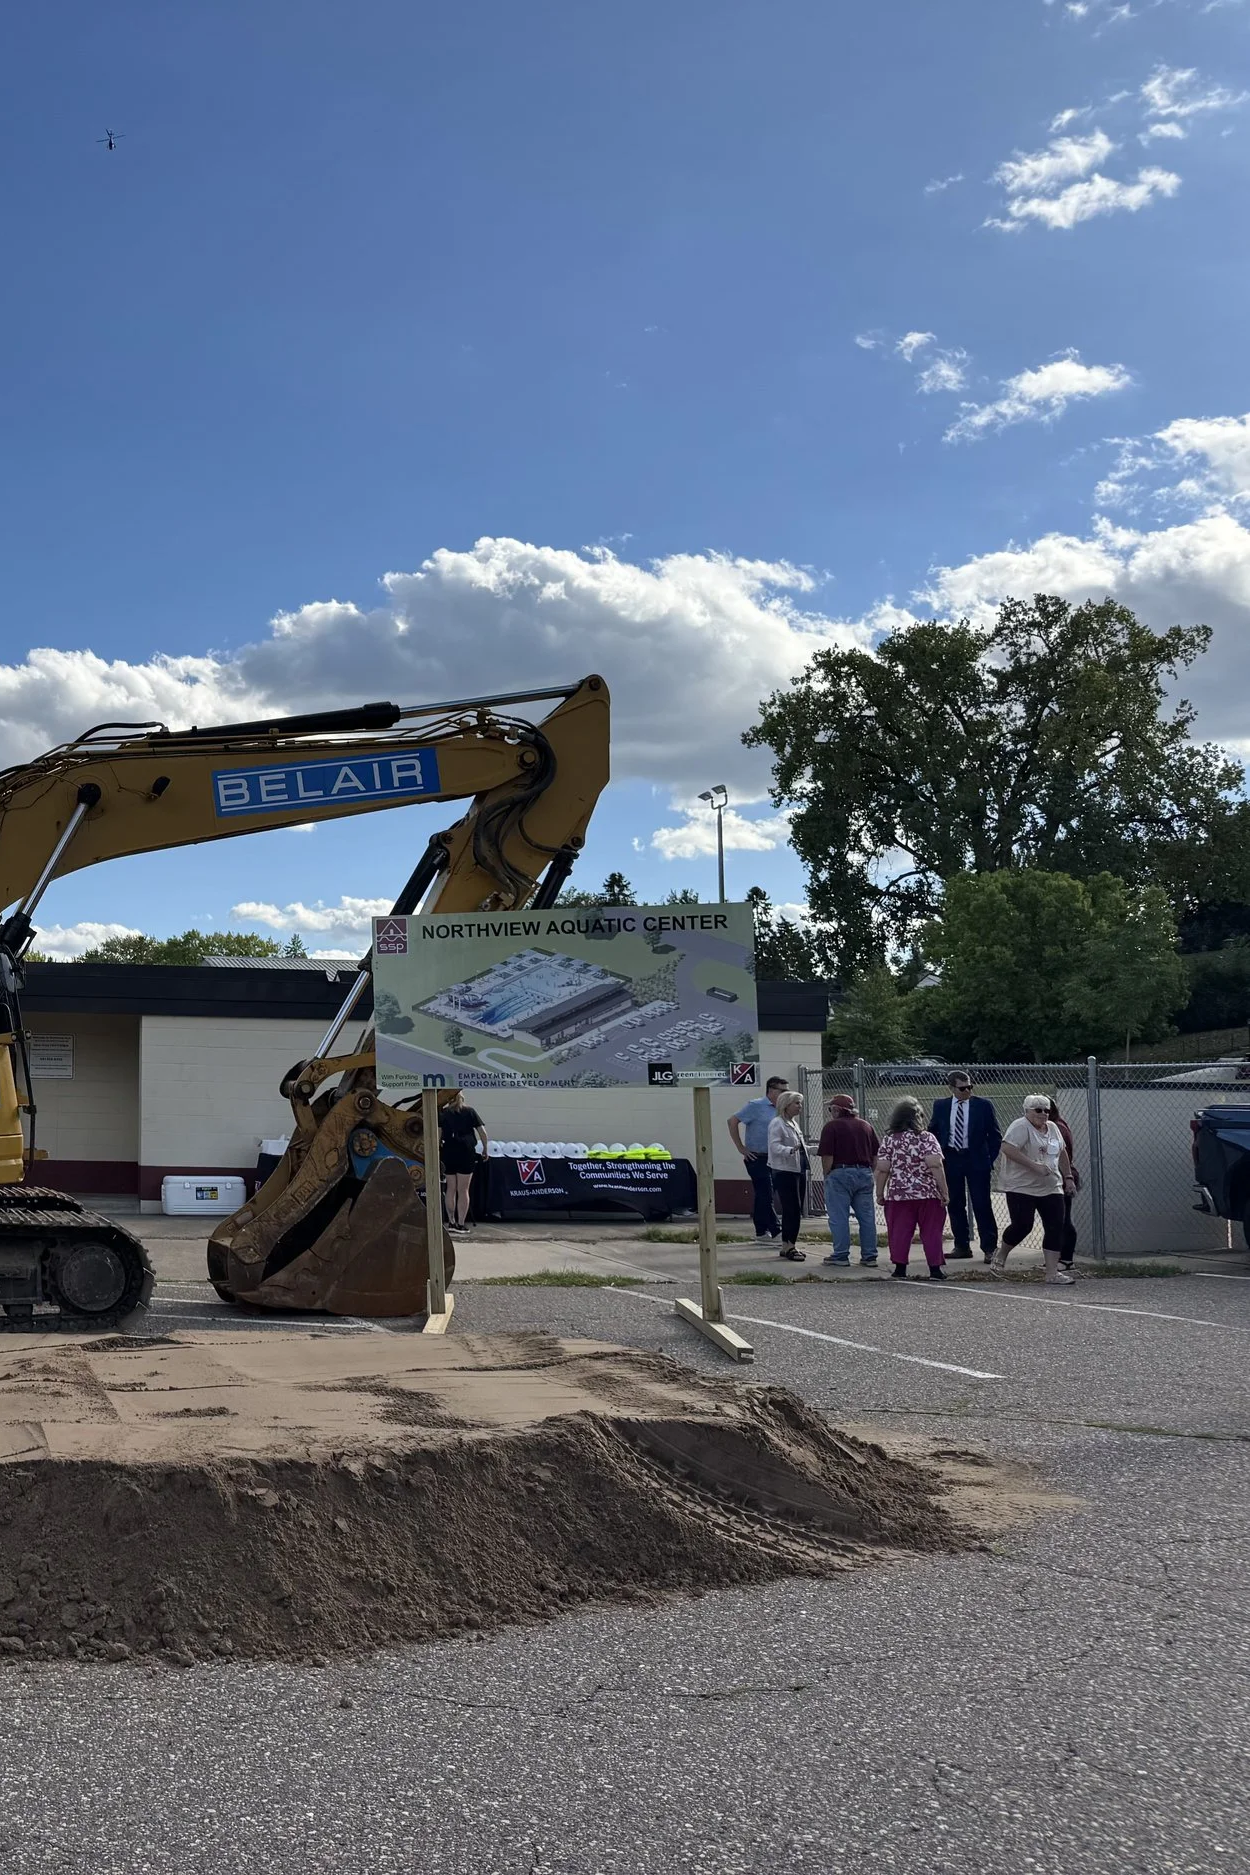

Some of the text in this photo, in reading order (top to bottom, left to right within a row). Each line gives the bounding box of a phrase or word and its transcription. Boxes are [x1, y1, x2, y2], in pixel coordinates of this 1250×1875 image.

[217, 758, 423, 807] BELAIR
[422, 914, 729, 940] NORTHVIEW AQUATIC CENTER
[379, 943, 404, 954] ssp
[395, 1073, 419, 1081] Funding
[458, 1072, 540, 1080] EMPLOYMENT AND
[652, 1071, 674, 1081] JLG
[568, 1161, 676, 1171] Together, Strengthening the
[579, 1170, 669, 1179] Communities We Serve
[509, 1187, 564, 1197] KRAUS-ANDERSON
